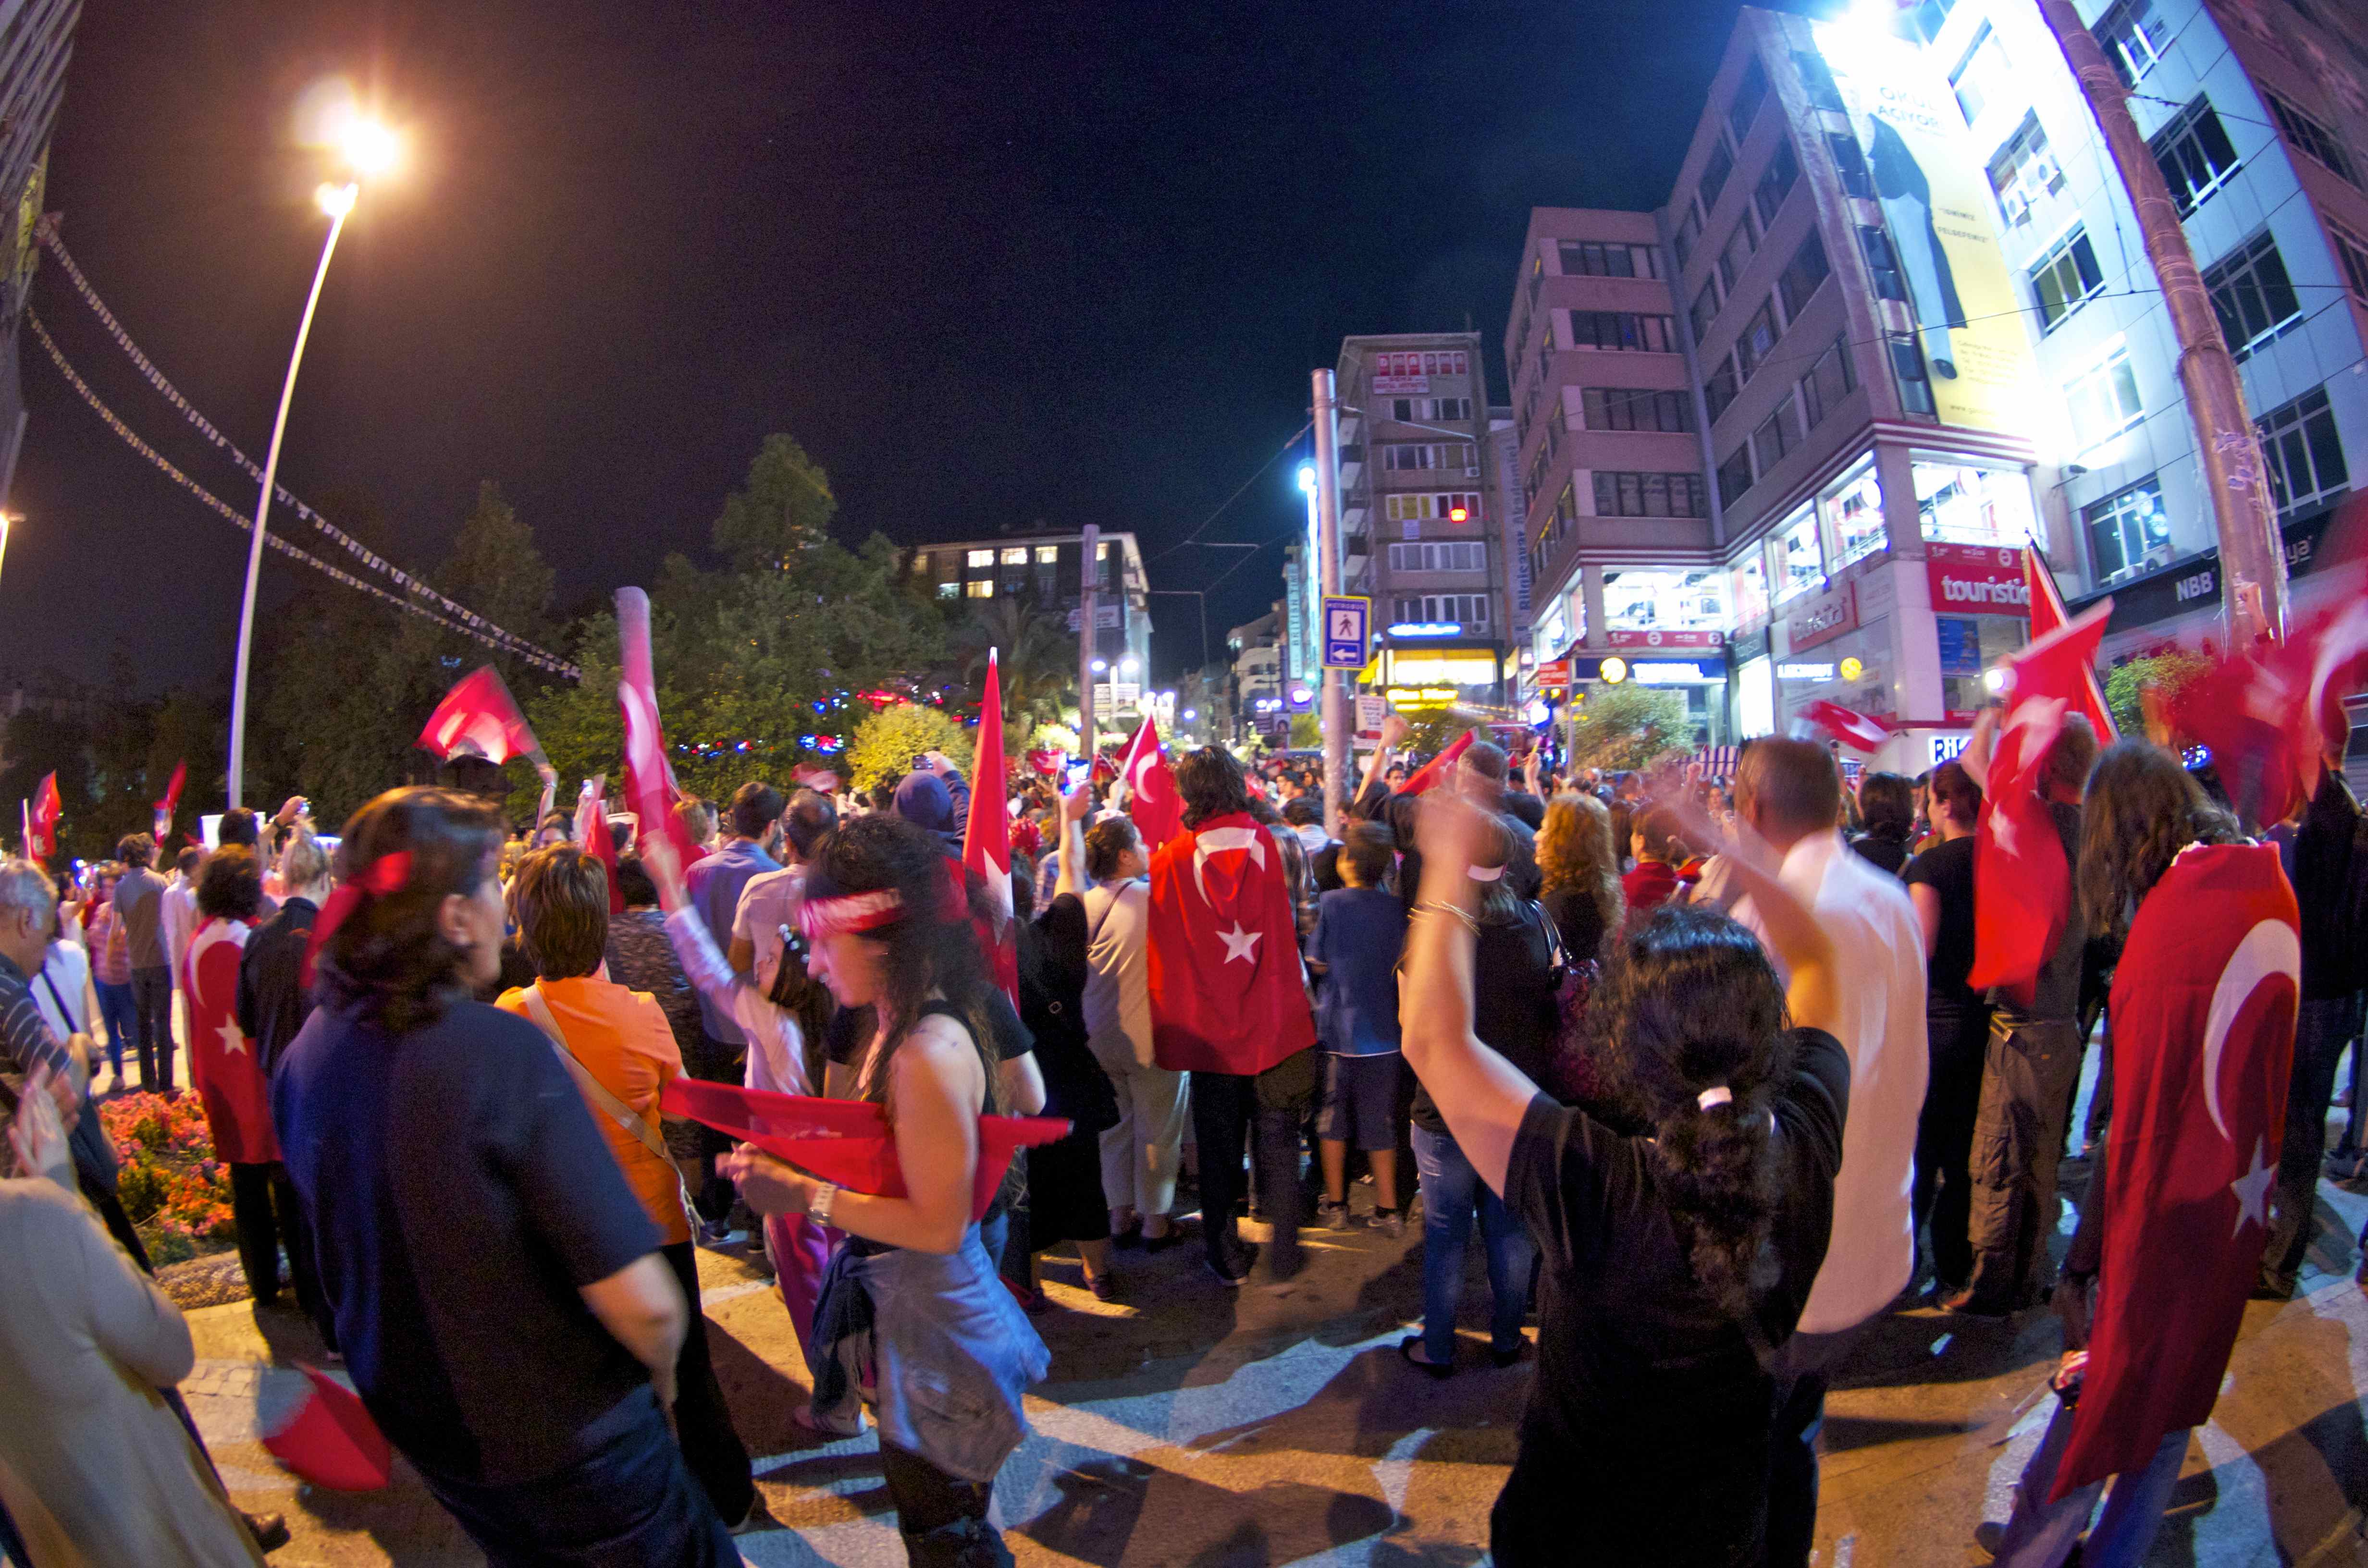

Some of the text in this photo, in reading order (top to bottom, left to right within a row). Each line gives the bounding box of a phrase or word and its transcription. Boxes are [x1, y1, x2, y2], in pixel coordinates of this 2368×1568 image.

[2285, 539, 2310, 566] ya
[1941, 575, 2031, 606] touristic
[2176, 571, 2214, 601] NBB
